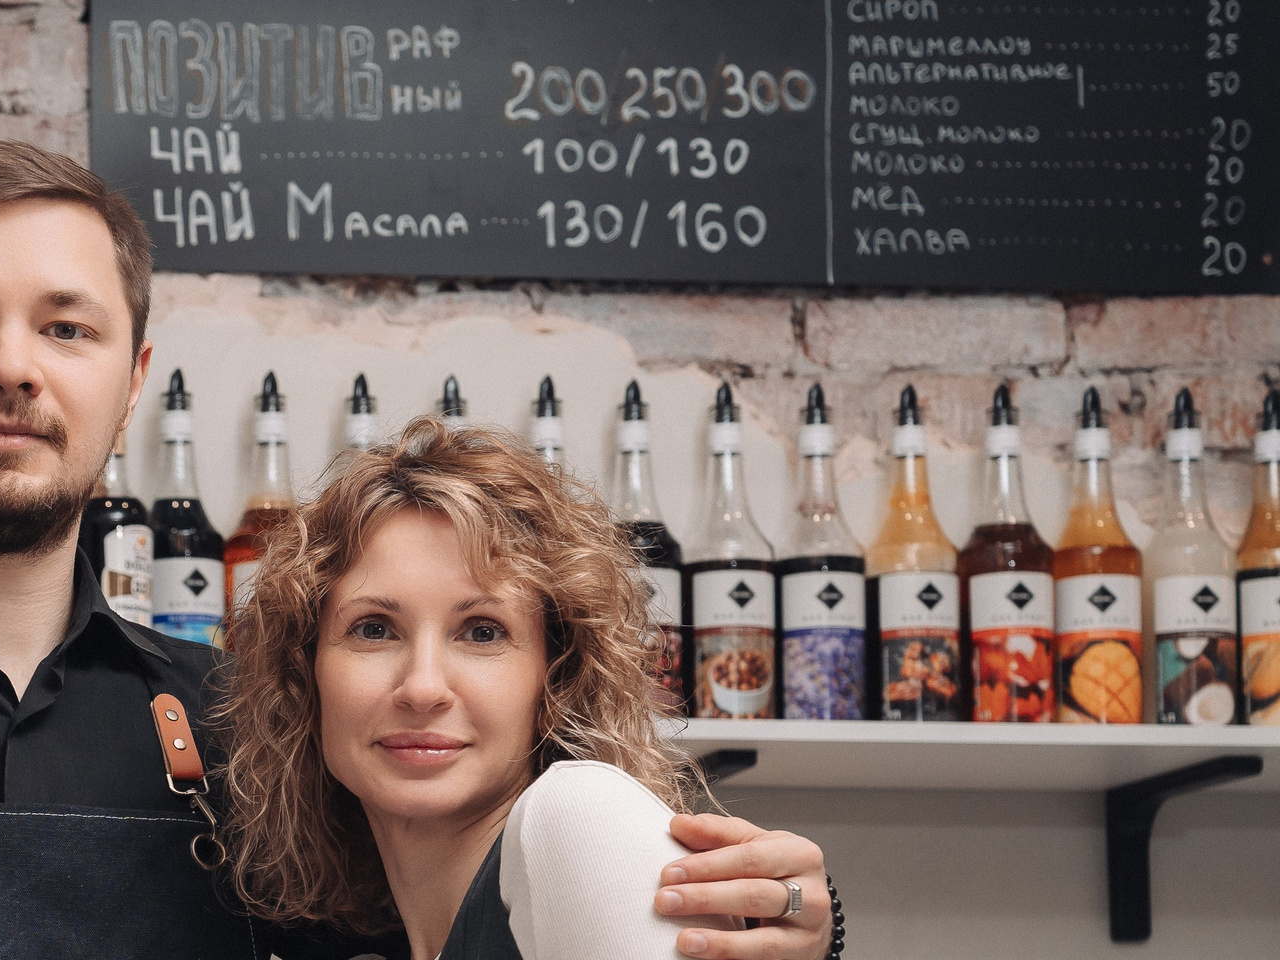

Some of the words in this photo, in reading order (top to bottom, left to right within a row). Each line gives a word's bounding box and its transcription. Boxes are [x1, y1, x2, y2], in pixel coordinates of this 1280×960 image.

[846, 0, 939, 22] СИРОП
[1207, 0, 1241, 27] 20
[1206, 33, 1240, 60] 25
[109, 18, 383, 124] ПОЗИТИВ
[386, 24, 461, 61] РАФ
[1206, 70, 1241, 97] 50
[390, 80, 462, 115] НЫЙ
[849, 94, 960, 117] МОЛОКО
[149, 122, 242, 175] ЧАЙ
[937, 125, 1040, 144] МОЛОКО
[1208, 116, 1252, 152] 20
[850, 150, 965, 177] МОЛОКО
[1205, 154, 1245, 185] 20
[152, 181, 256, 248] ЧАЙ
[1201, 192, 1247, 229] 20
[853, 227, 971, 256] ХАЛВА
[1201, 235, 1248, 277] 20
